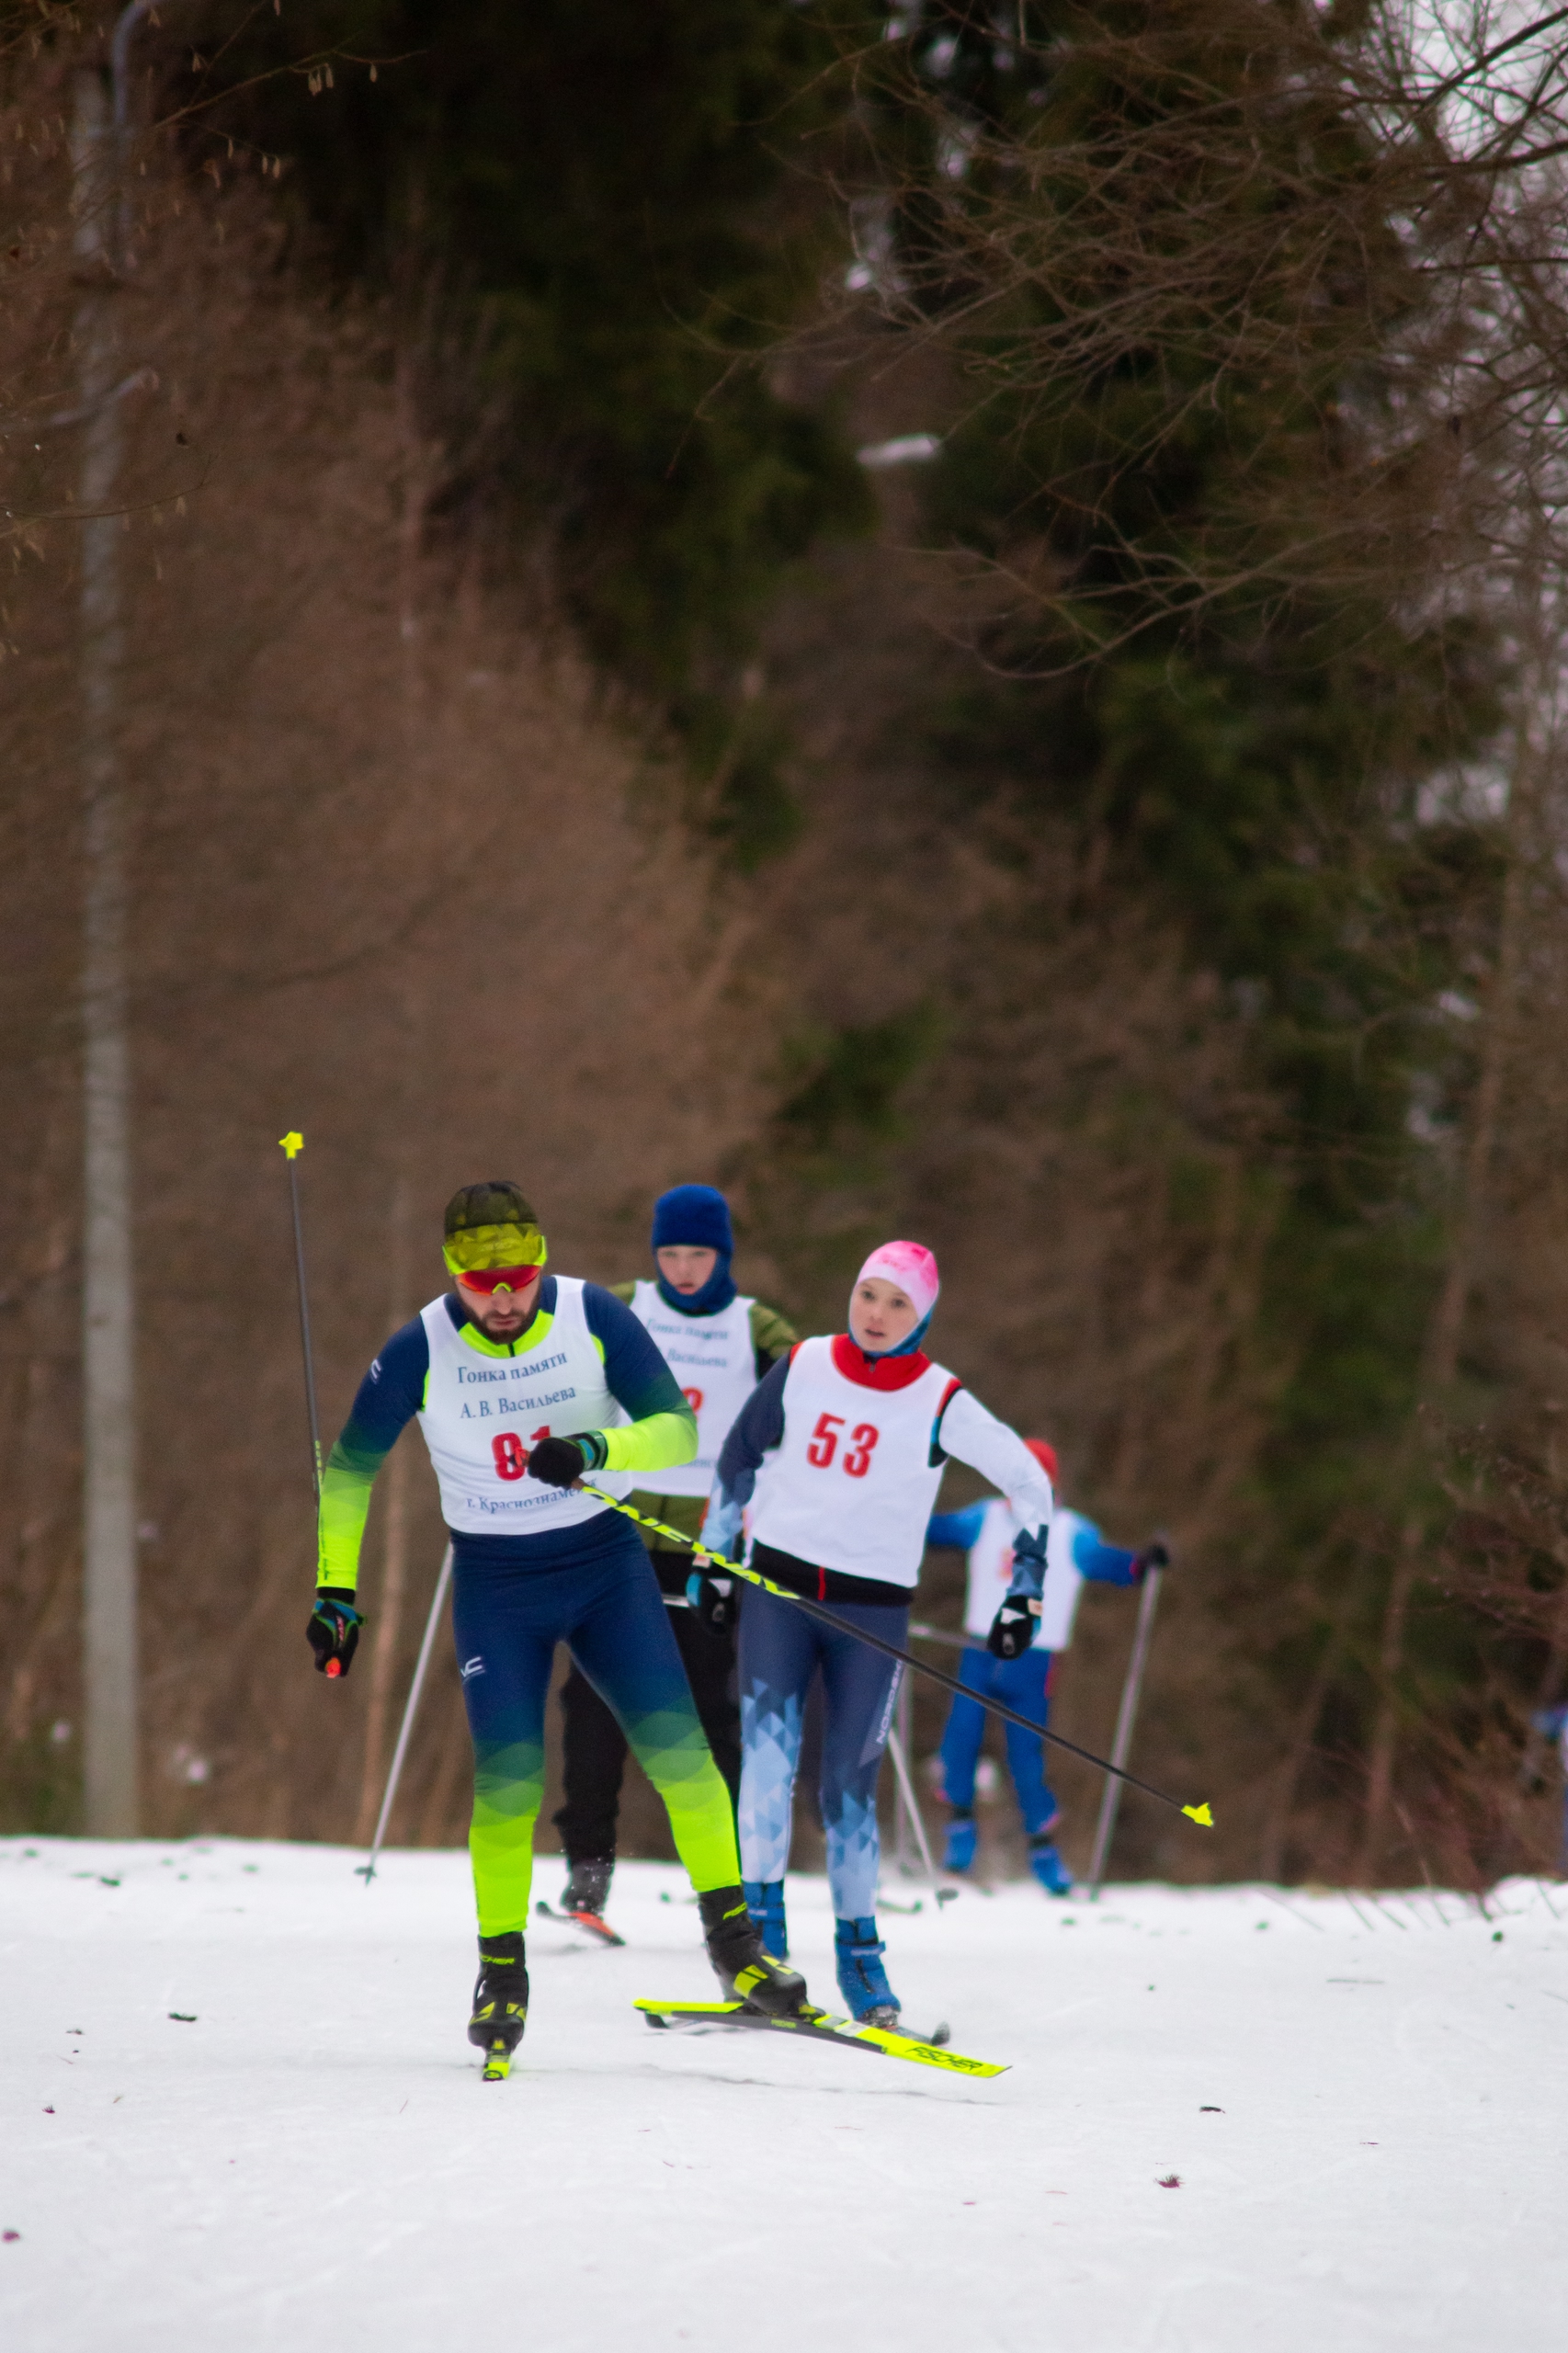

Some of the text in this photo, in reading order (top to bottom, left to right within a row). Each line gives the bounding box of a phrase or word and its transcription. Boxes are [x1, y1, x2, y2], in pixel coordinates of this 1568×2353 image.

[457, 1352, 568, 1384] Гонка памяти
[460, 1386, 576, 1419] А. В. Васильева
[806, 1412, 880, 1478] 53
[478, 1478, 597, 1515] Краснознамек
[904, 2046, 983, 2072] FISCHER
